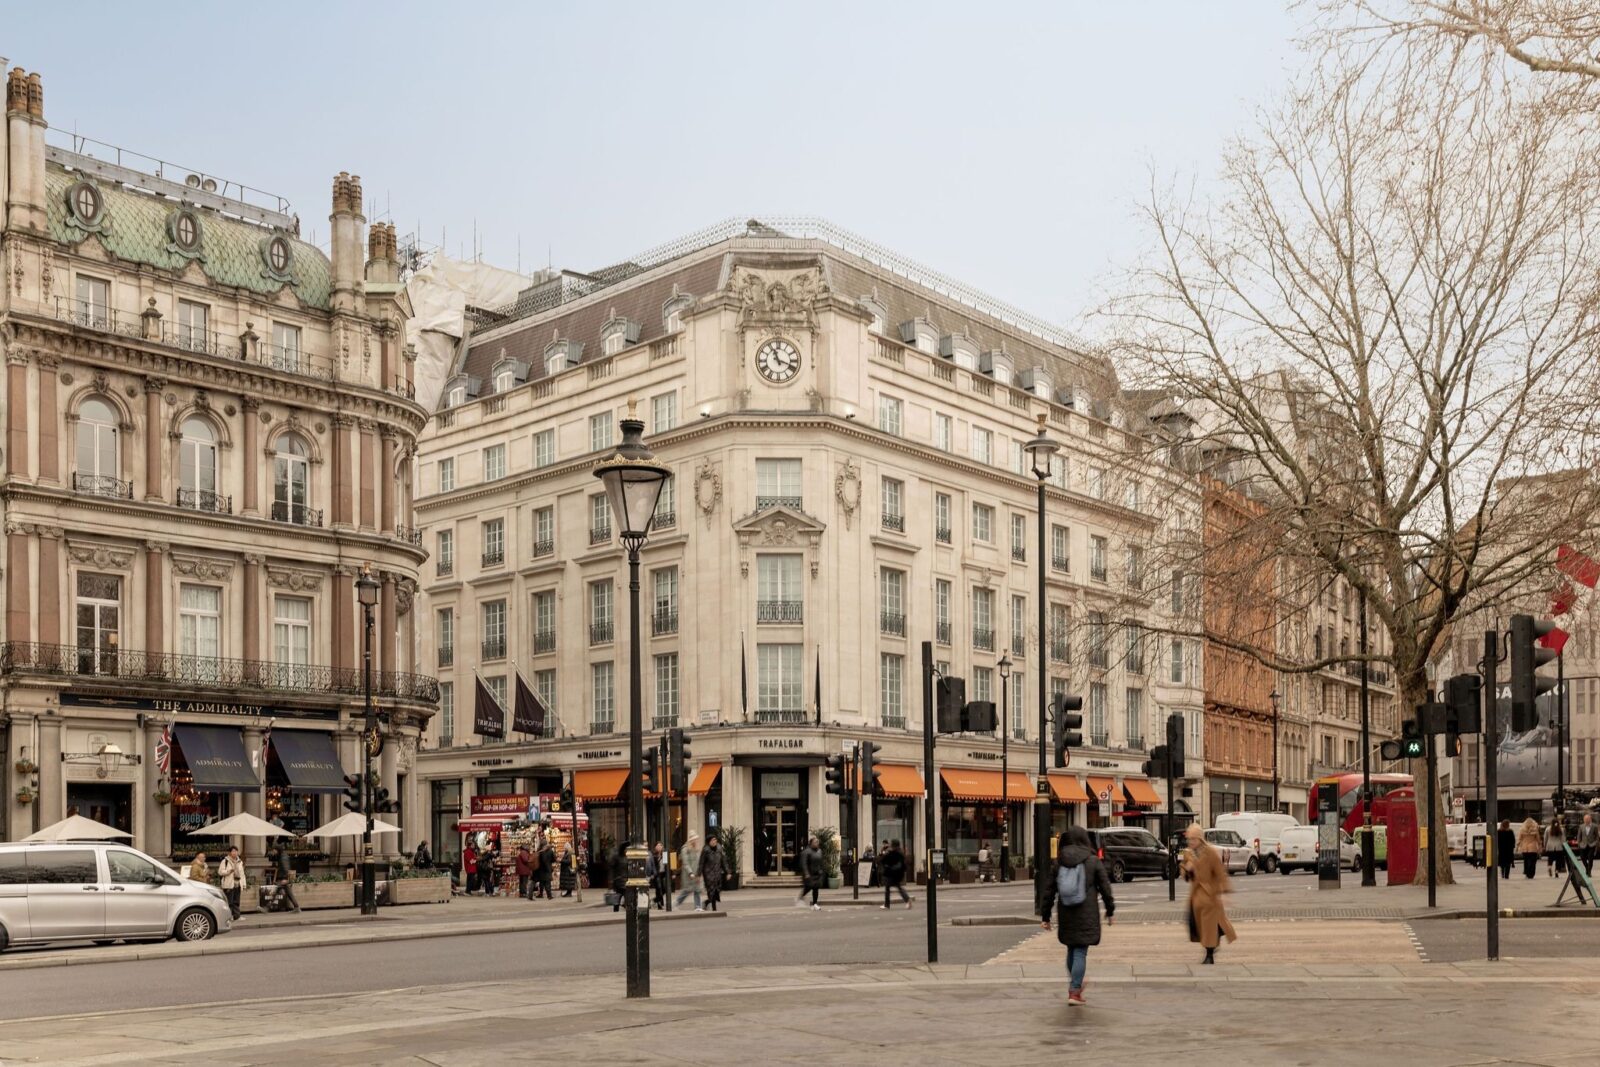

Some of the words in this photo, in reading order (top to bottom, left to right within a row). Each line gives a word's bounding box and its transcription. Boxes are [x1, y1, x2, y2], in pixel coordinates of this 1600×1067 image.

[153, 700, 181, 711] THE
[186, 702, 262, 716] ADMIRALTY
[758, 740, 804, 748] TRAFALGAR
[583, 750, 609, 759] TRAFALGAR
[972, 752, 996, 760] TRAFALGAR
[195, 759, 242, 768] ADMIRALTY
[290, 762, 334, 770] ADMIRALTY
[477, 758, 502, 766] TRAFALGAR
[180, 814, 205, 824] RUGBY
